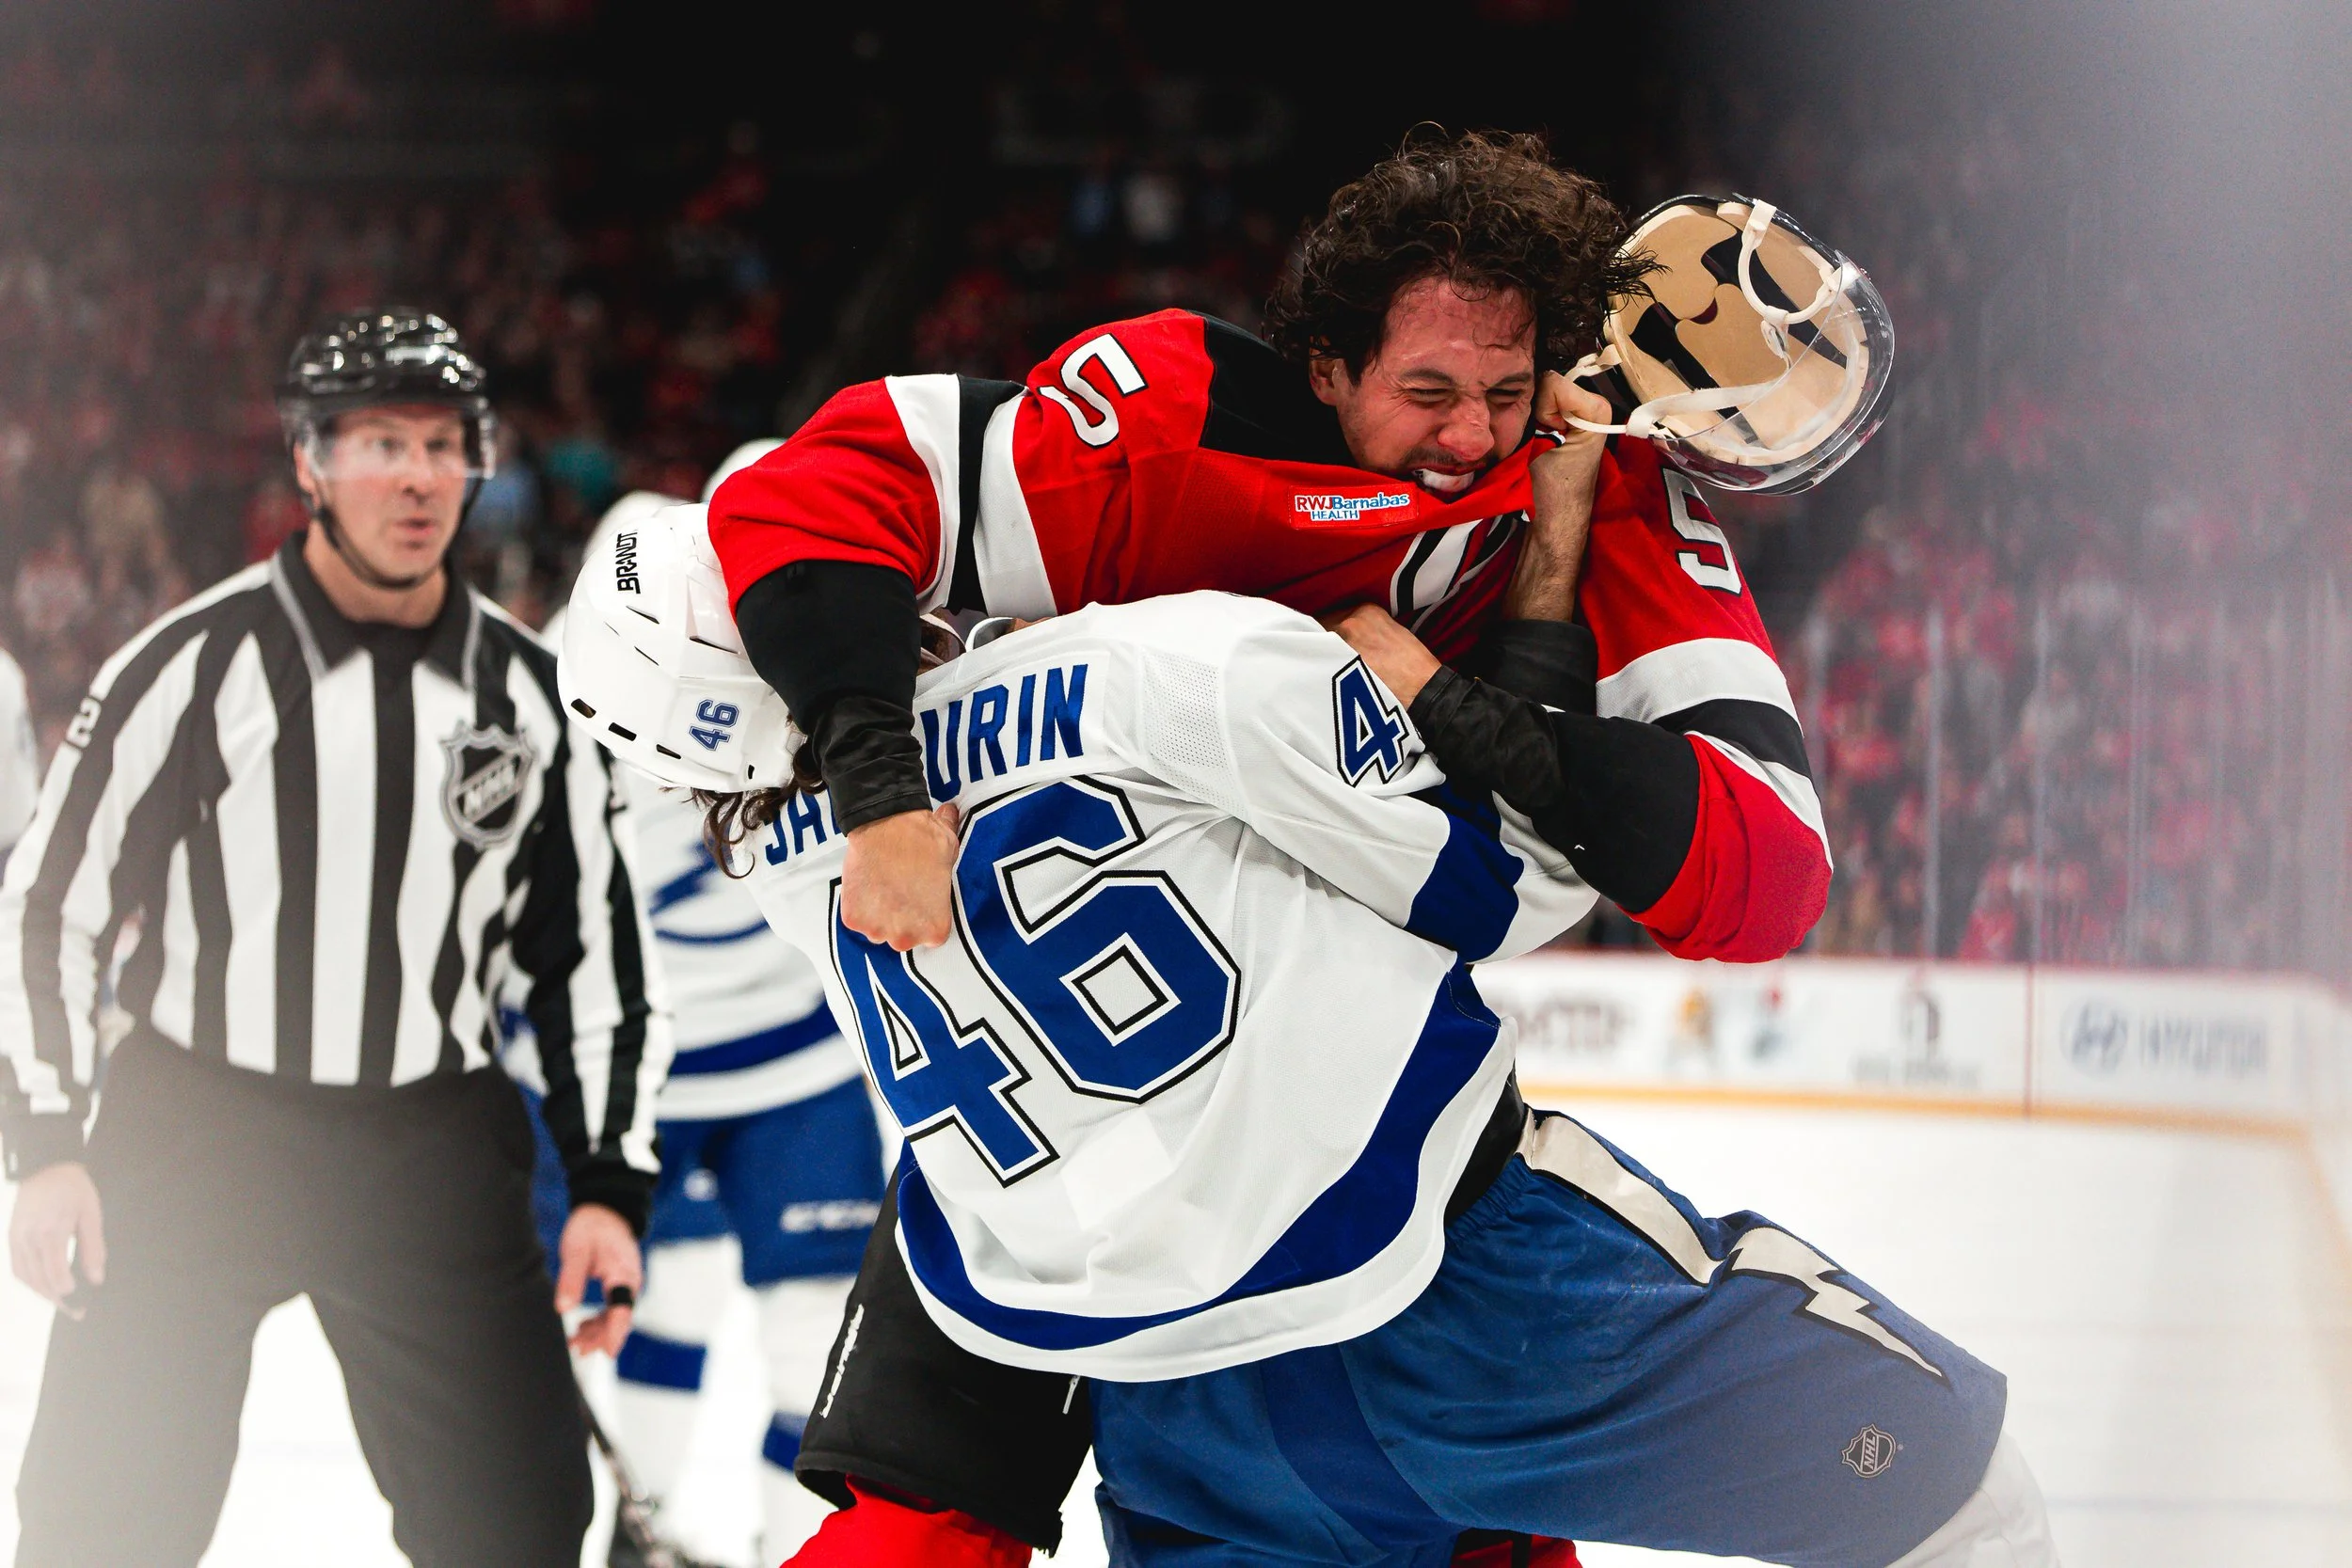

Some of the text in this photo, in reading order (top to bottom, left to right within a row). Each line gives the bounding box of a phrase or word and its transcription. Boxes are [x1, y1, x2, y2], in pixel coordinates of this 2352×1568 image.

[1037, 332, 1149, 450] 5
[1295, 492, 1409, 512] RWJBarnabas
[1311, 509, 1359, 520] HEALTH
[1661, 467, 1743, 596] 5
[615, 530, 641, 594] BRANDT
[689, 699, 739, 752] 46
[828, 774, 1241, 1188] 46
[1864, 1435, 1877, 1470] NHL
